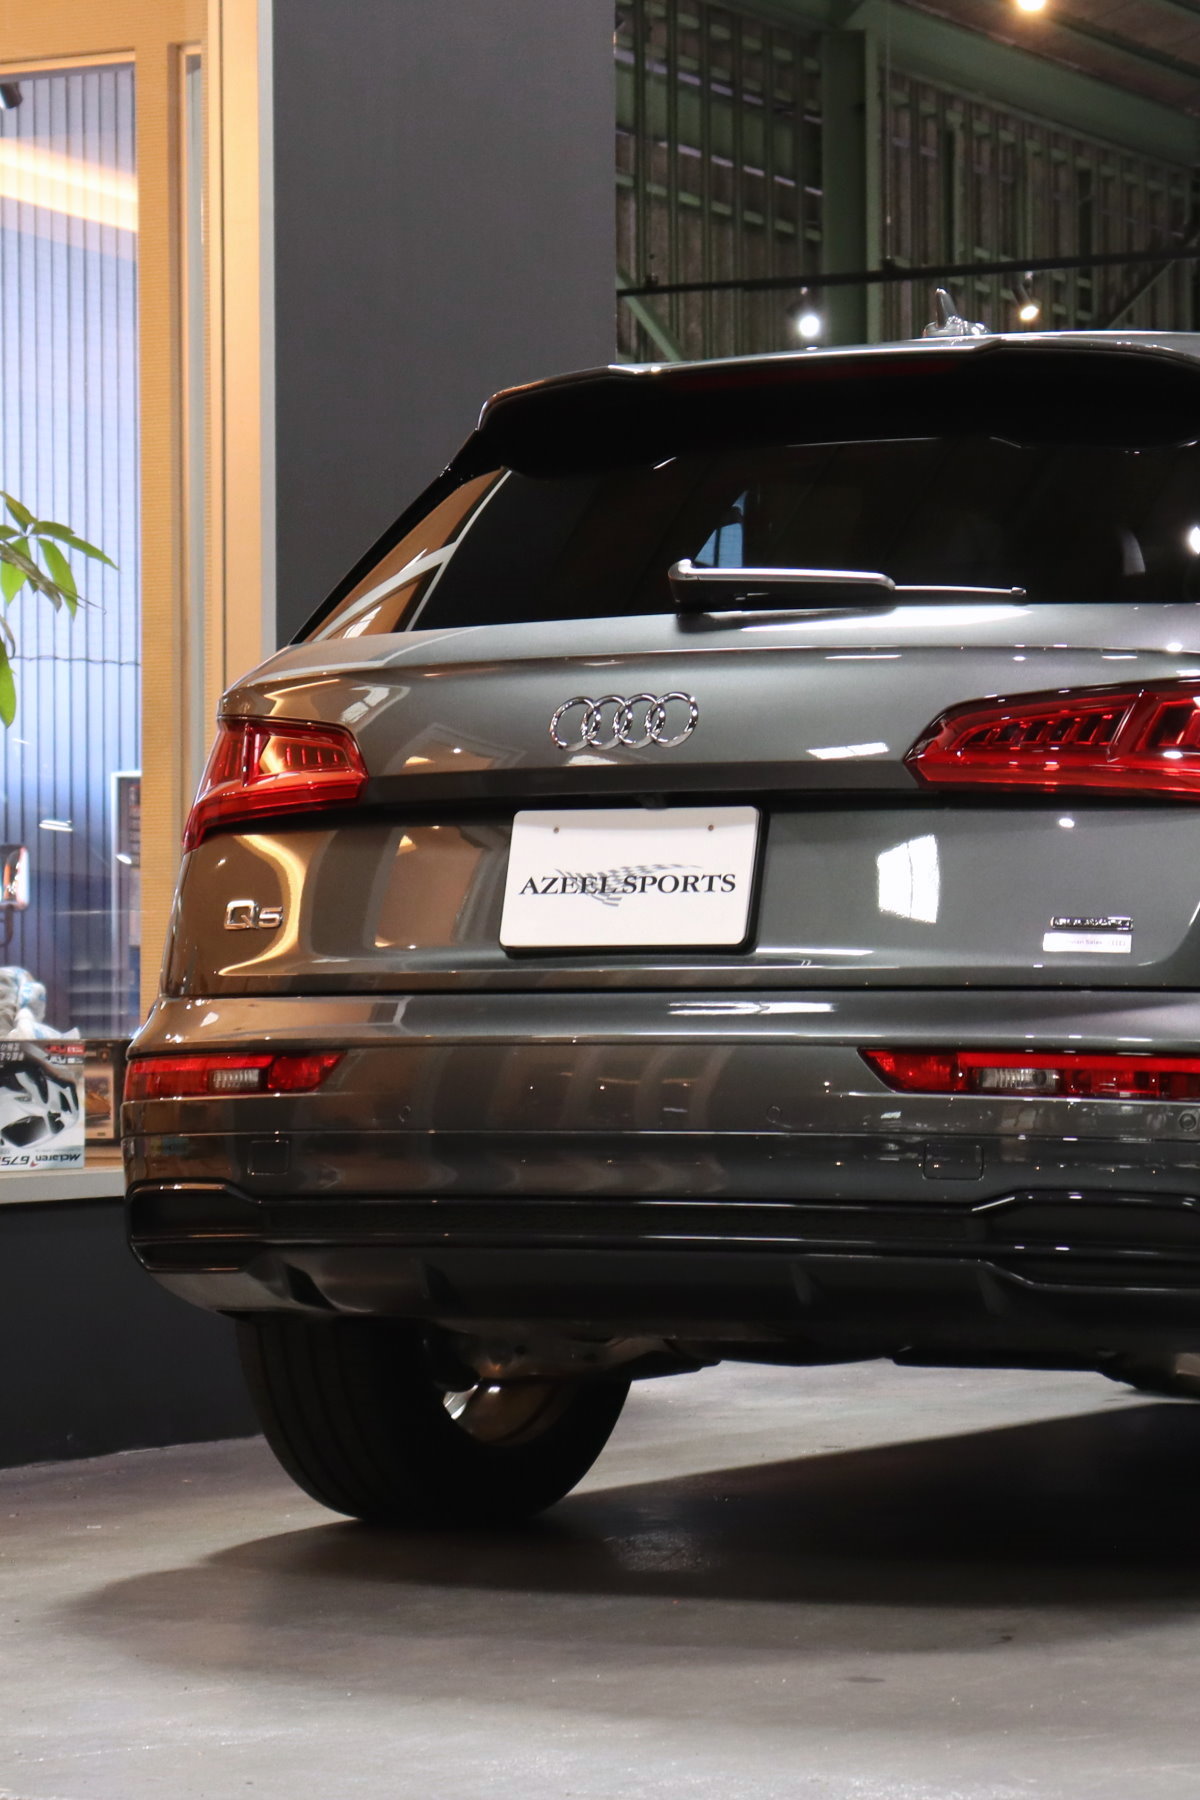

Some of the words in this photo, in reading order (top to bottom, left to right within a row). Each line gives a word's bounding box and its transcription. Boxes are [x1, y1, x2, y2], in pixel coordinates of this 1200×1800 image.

[519, 876, 617, 895] AZEEL
[622, 873, 736, 894] SPORTS
[224, 899, 284, 930] Q5
[0, 1155, 30, 1166] 675
